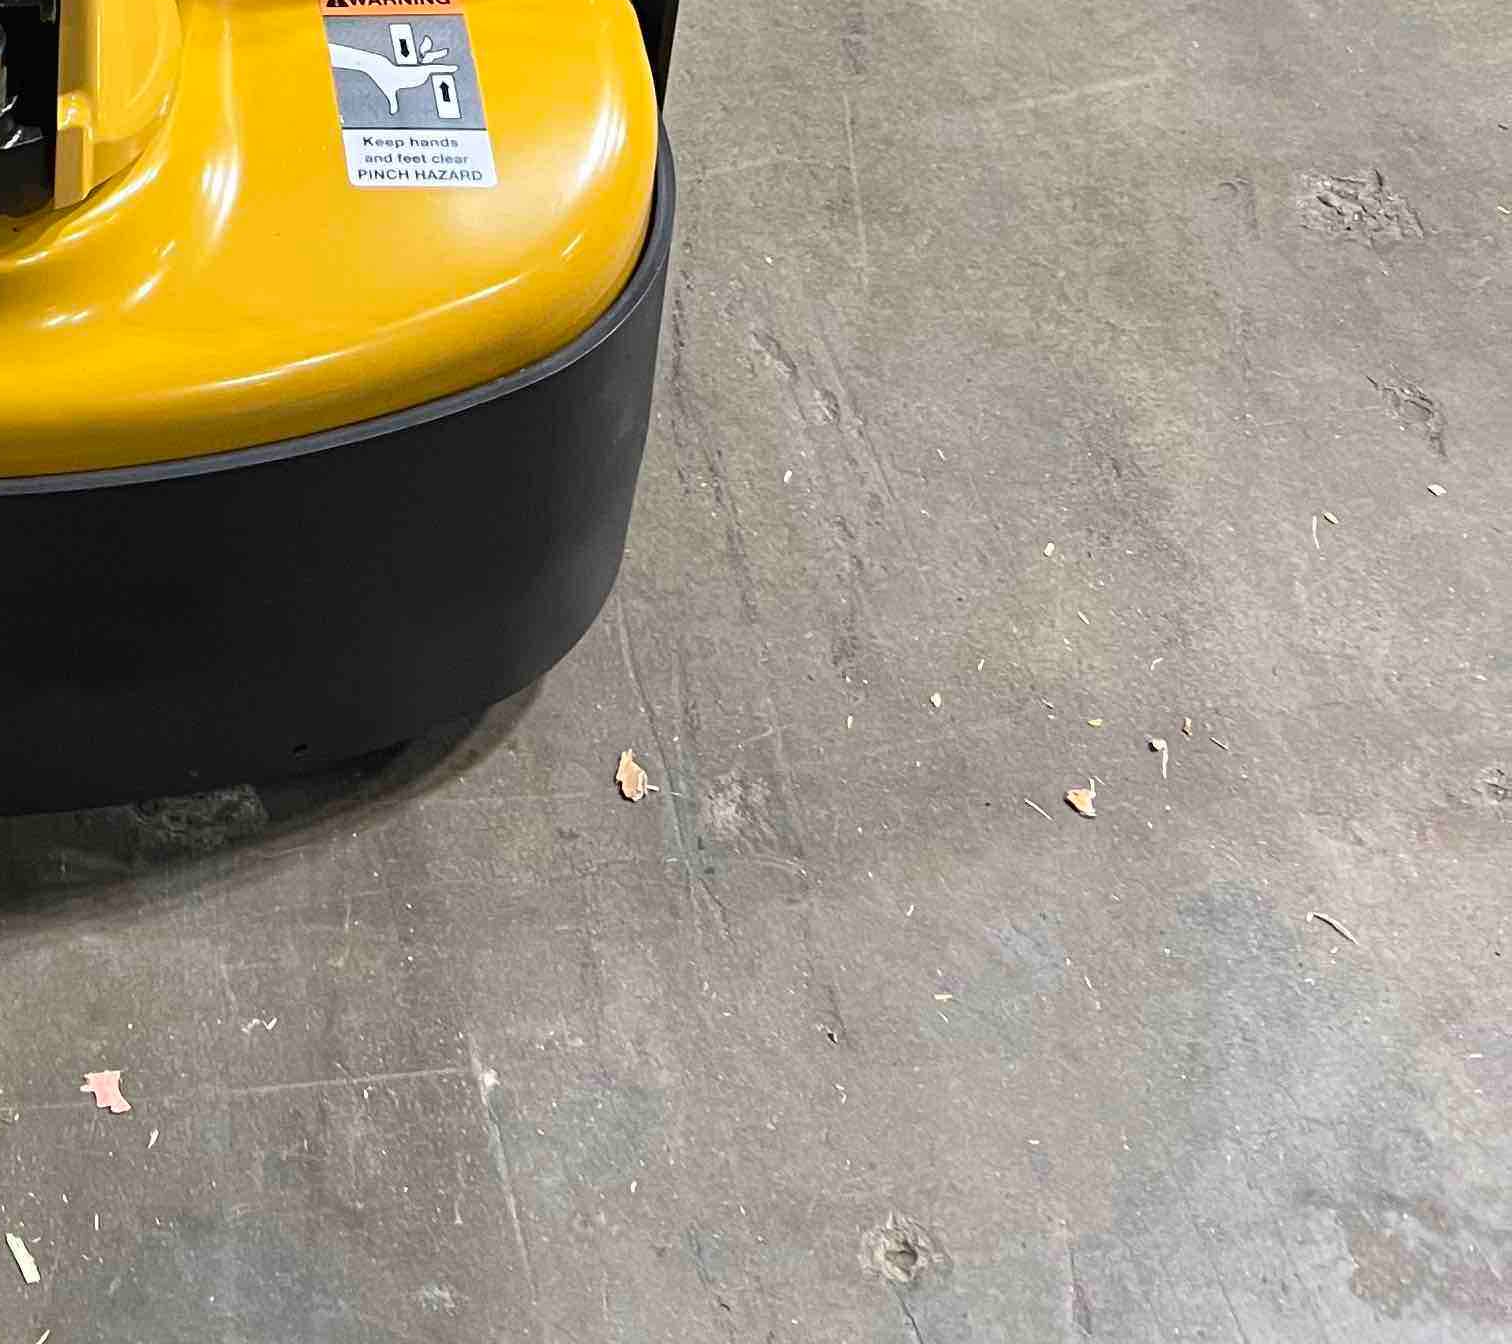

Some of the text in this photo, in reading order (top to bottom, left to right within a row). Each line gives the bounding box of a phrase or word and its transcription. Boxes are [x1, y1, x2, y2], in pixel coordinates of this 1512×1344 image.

[362, 136, 459, 149] Keep hands
[364, 153, 469, 164] and feet clear
[358, 169, 483, 181] PINCH HAZARD
